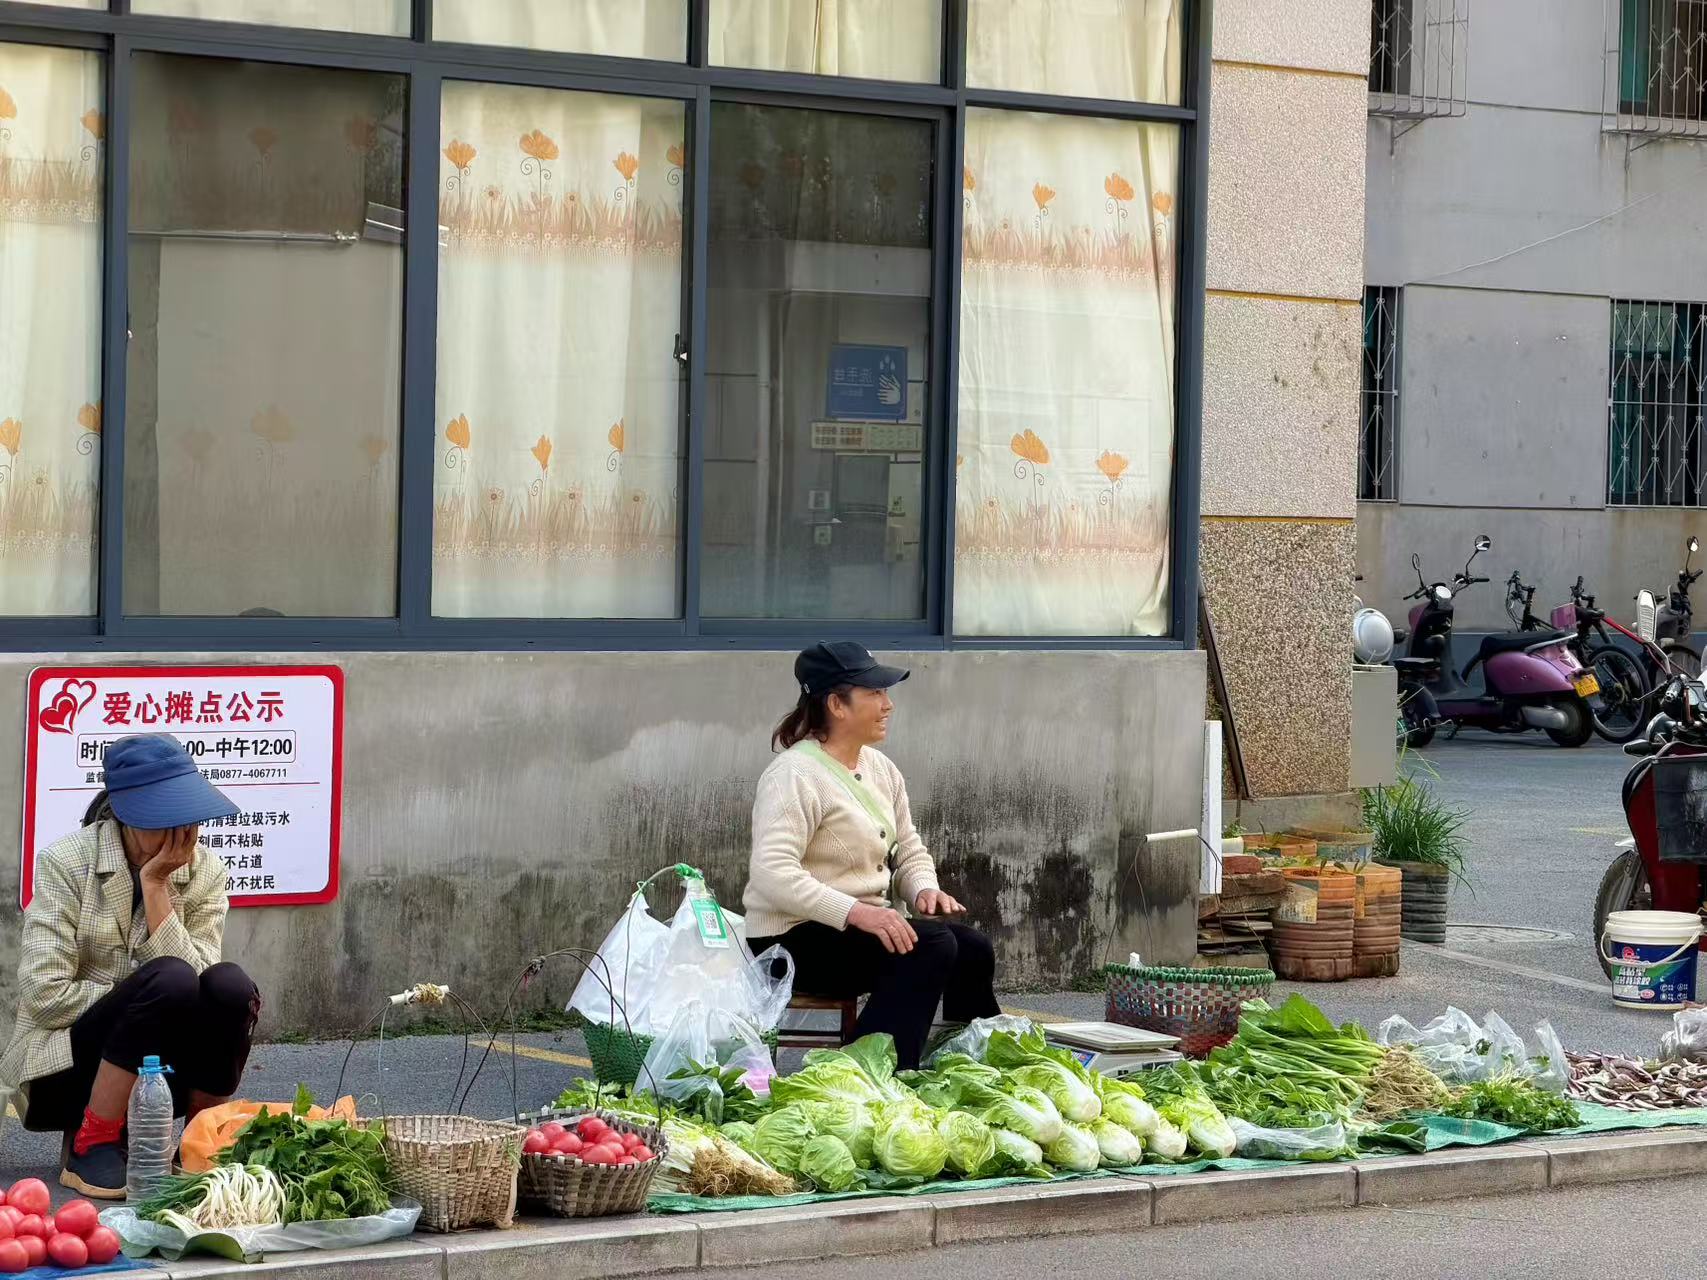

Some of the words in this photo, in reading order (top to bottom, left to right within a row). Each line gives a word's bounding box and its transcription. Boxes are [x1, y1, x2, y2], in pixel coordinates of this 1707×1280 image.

[102, 690, 284, 725] 爱心摊点公示
[198, 832, 264, 848] 刻画不粘贴
[219, 853, 263, 869] 不占道
